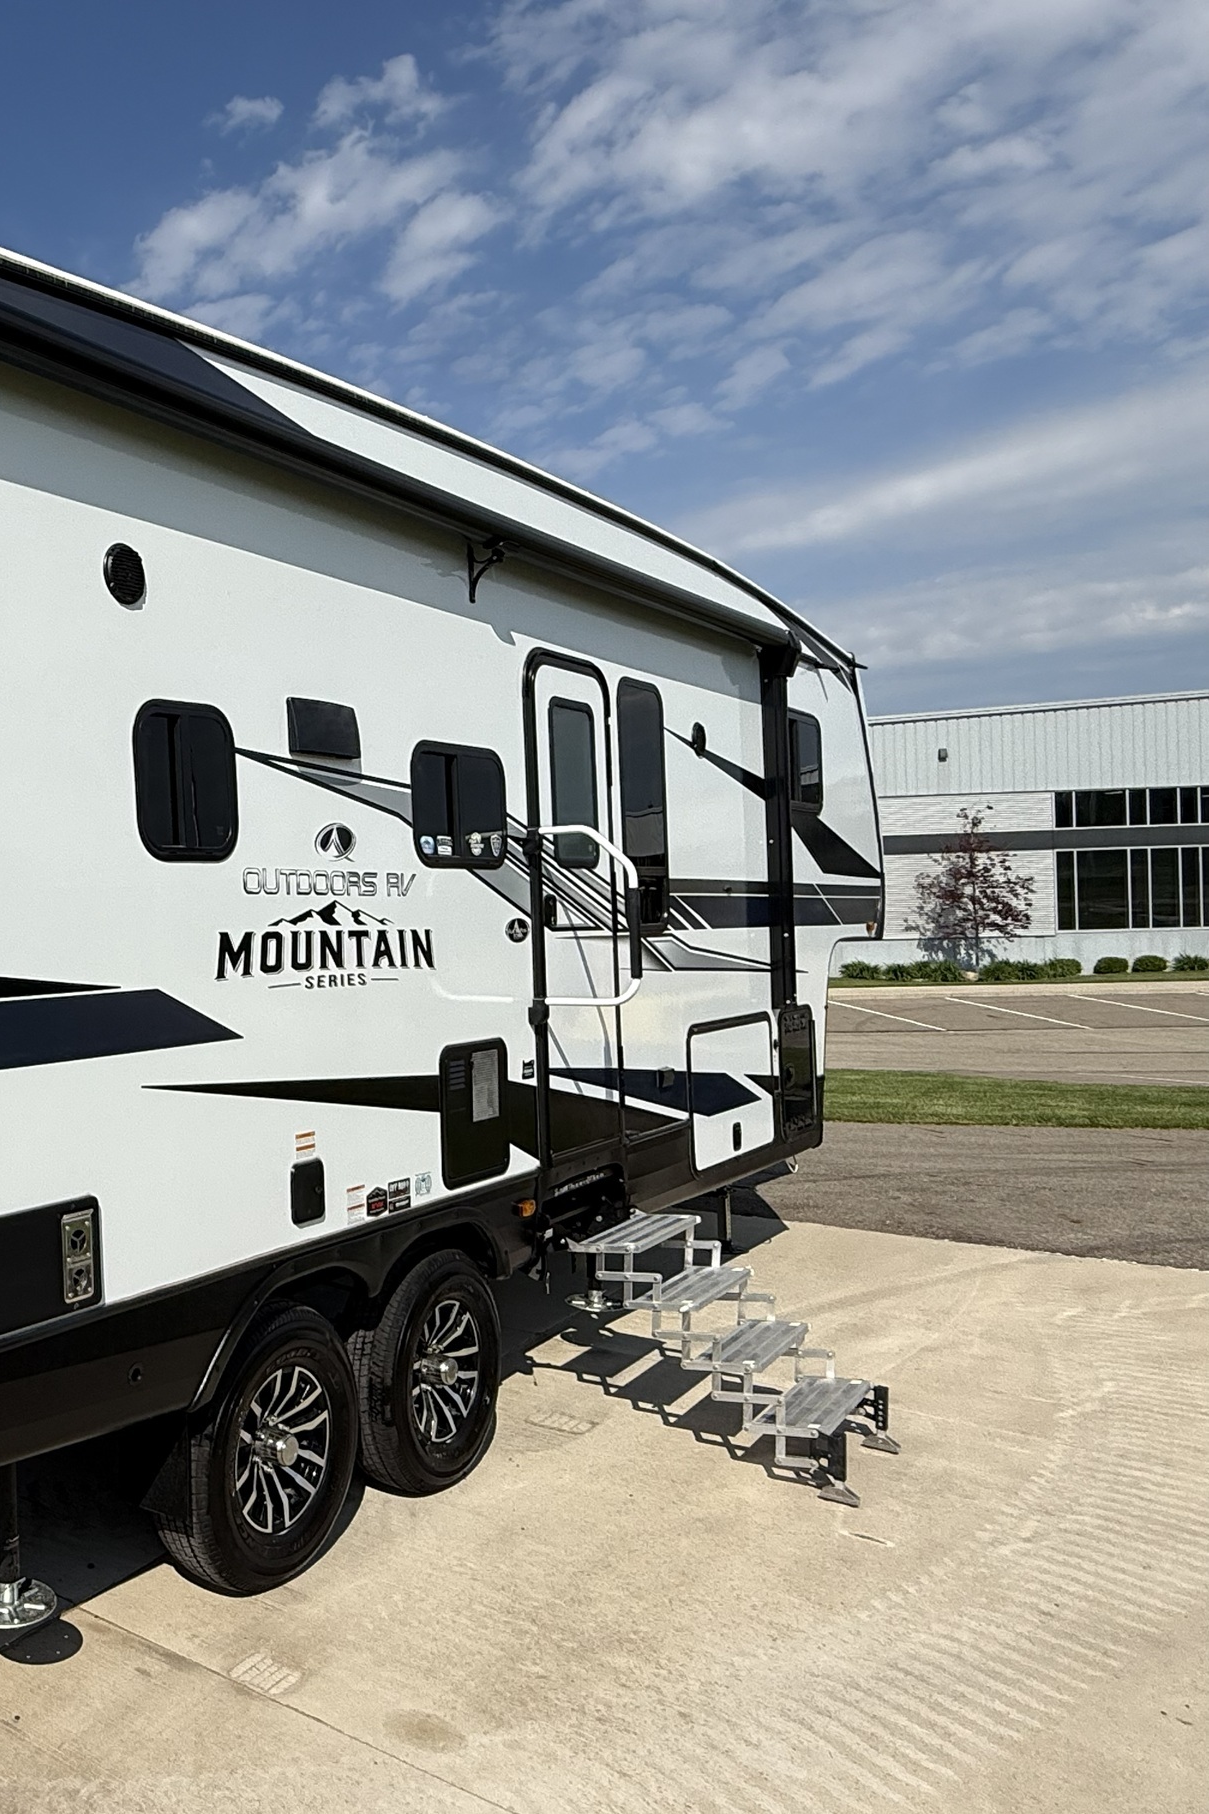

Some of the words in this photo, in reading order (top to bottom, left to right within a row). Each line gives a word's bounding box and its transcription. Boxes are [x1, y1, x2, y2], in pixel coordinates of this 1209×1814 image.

[243, 868, 378, 896] OUTDOORS
[387, 872, 417, 897] RV
[215, 929, 437, 981] MOUNTAIN
[304, 973, 367, 989] SERIES
